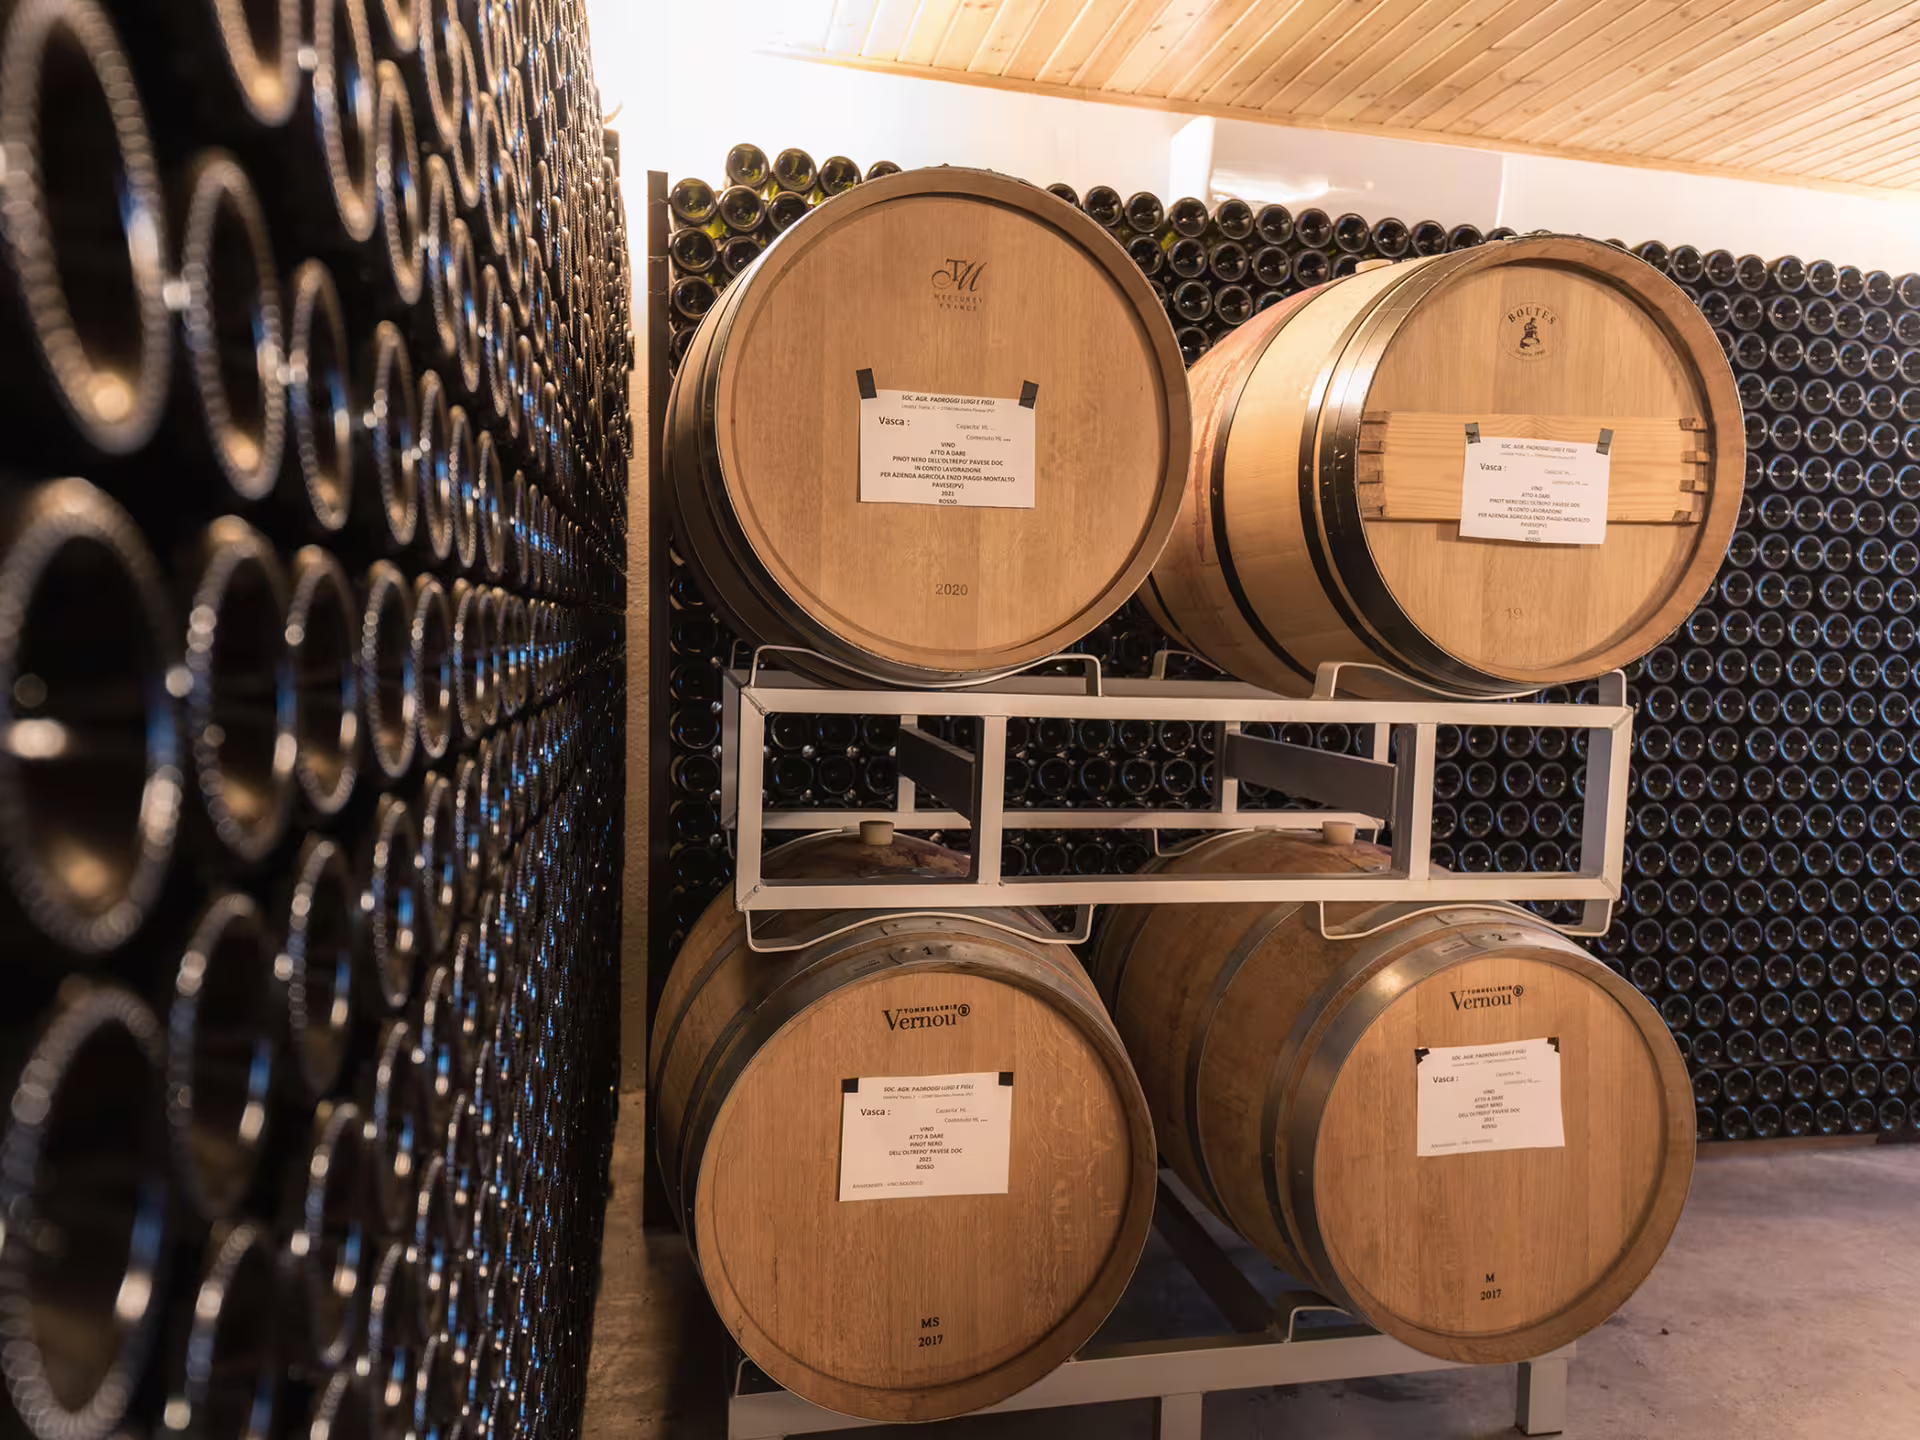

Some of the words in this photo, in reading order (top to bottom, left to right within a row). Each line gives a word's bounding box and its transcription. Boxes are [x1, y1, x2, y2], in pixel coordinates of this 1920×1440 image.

[940, 303, 977, 311] FRANCE
[1508, 306, 1556, 325] BOUTES
[930, 396, 960, 404] PADROGGI
[879, 416, 905, 426] Vasca
[1480, 463, 1502, 471] Vasca
[935, 583, 968, 596] 2020
[1449, 990, 1512, 1011] Vernou
[882, 1009, 957, 1031] Vernou
[1432, 1076, 1455, 1084] Vasca
[860, 1108, 886, 1116] Vasca
[1485, 1272, 1495, 1283] M
[1480, 1289, 1502, 1300] 2017
[921, 1316, 940, 1328] MS
[918, 1334, 944, 1347] 2017
